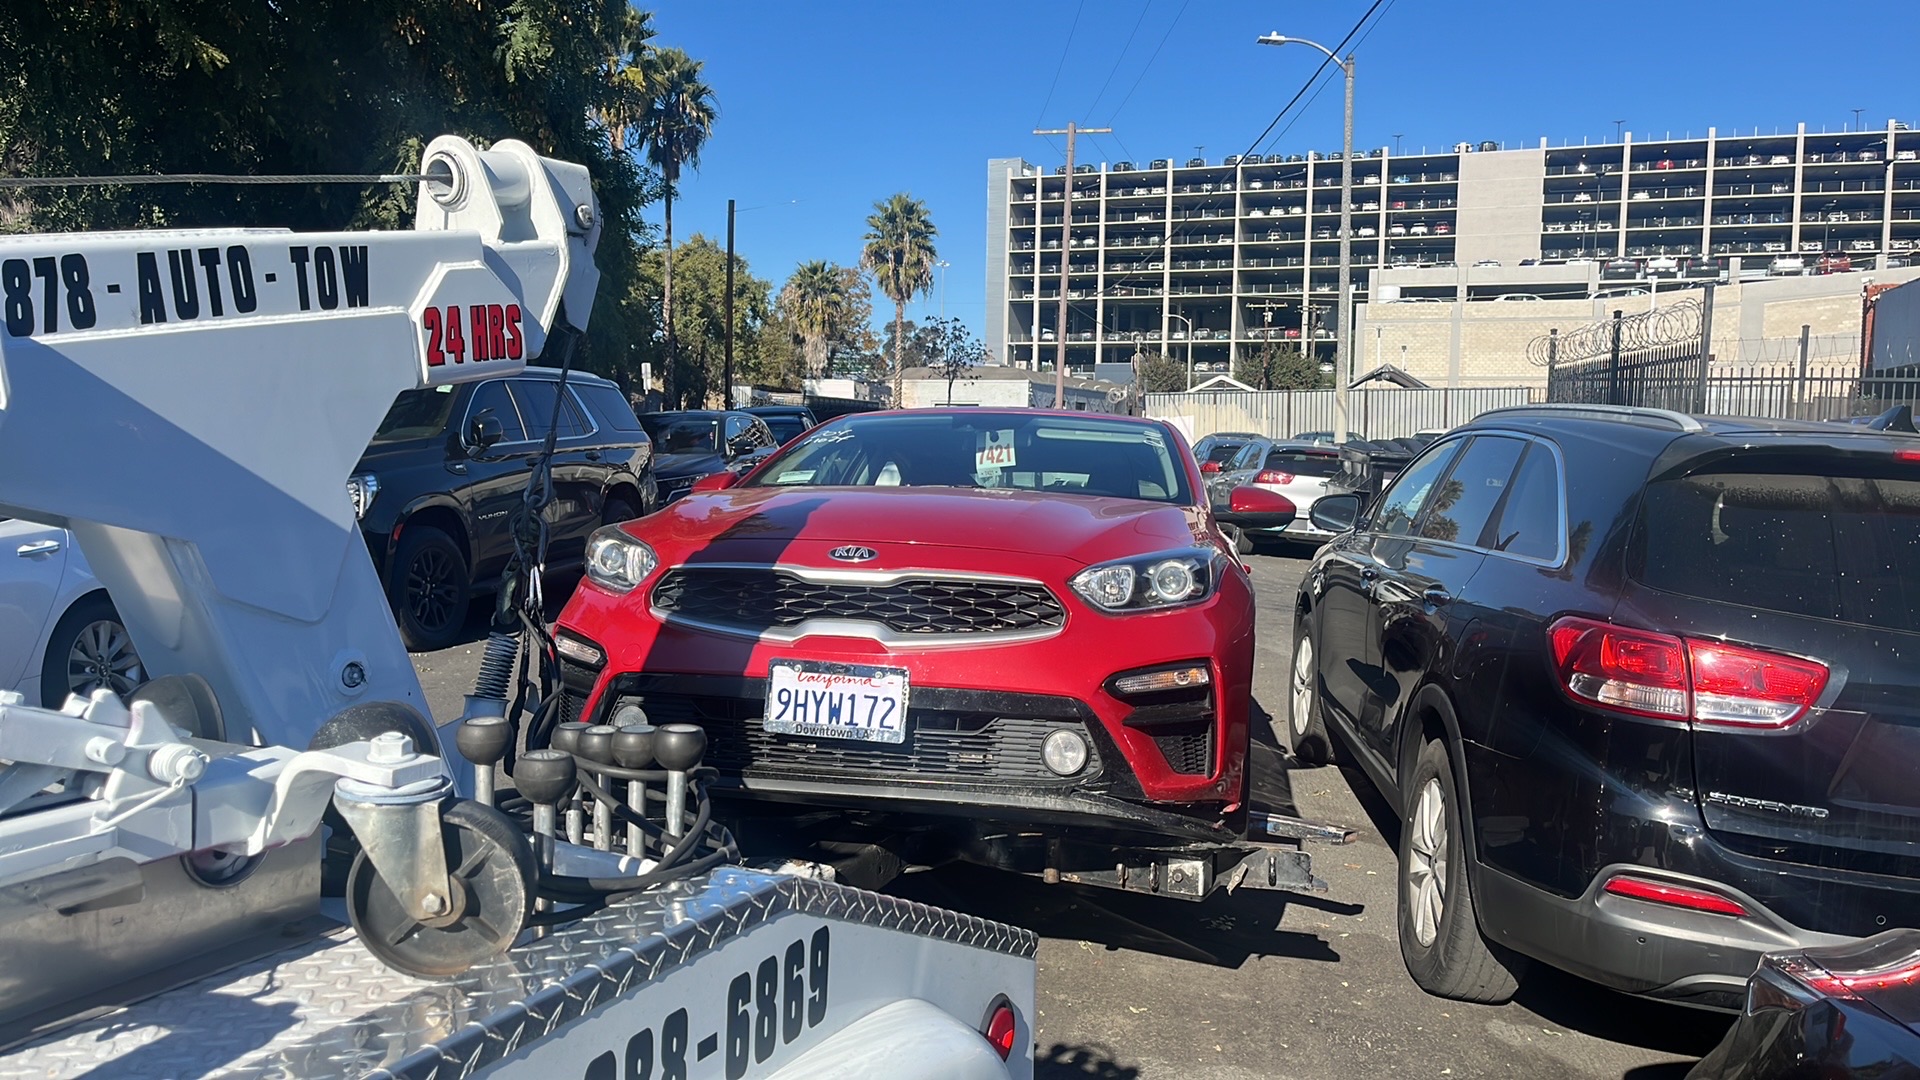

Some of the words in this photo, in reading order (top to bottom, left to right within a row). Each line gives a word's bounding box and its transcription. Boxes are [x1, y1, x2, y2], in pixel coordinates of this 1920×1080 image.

[424, 305, 465, 367] 24
[470, 304, 523, 362] HRS
[978, 443, 1012, 465] 7421
[478, 510, 509, 520] YUKON
[834, 546, 869, 558] KIA
[775, 688, 896, 730] 9HYW172
[795, 723, 853, 738] Downtown
[1708, 791, 1829, 818] SORENTO
